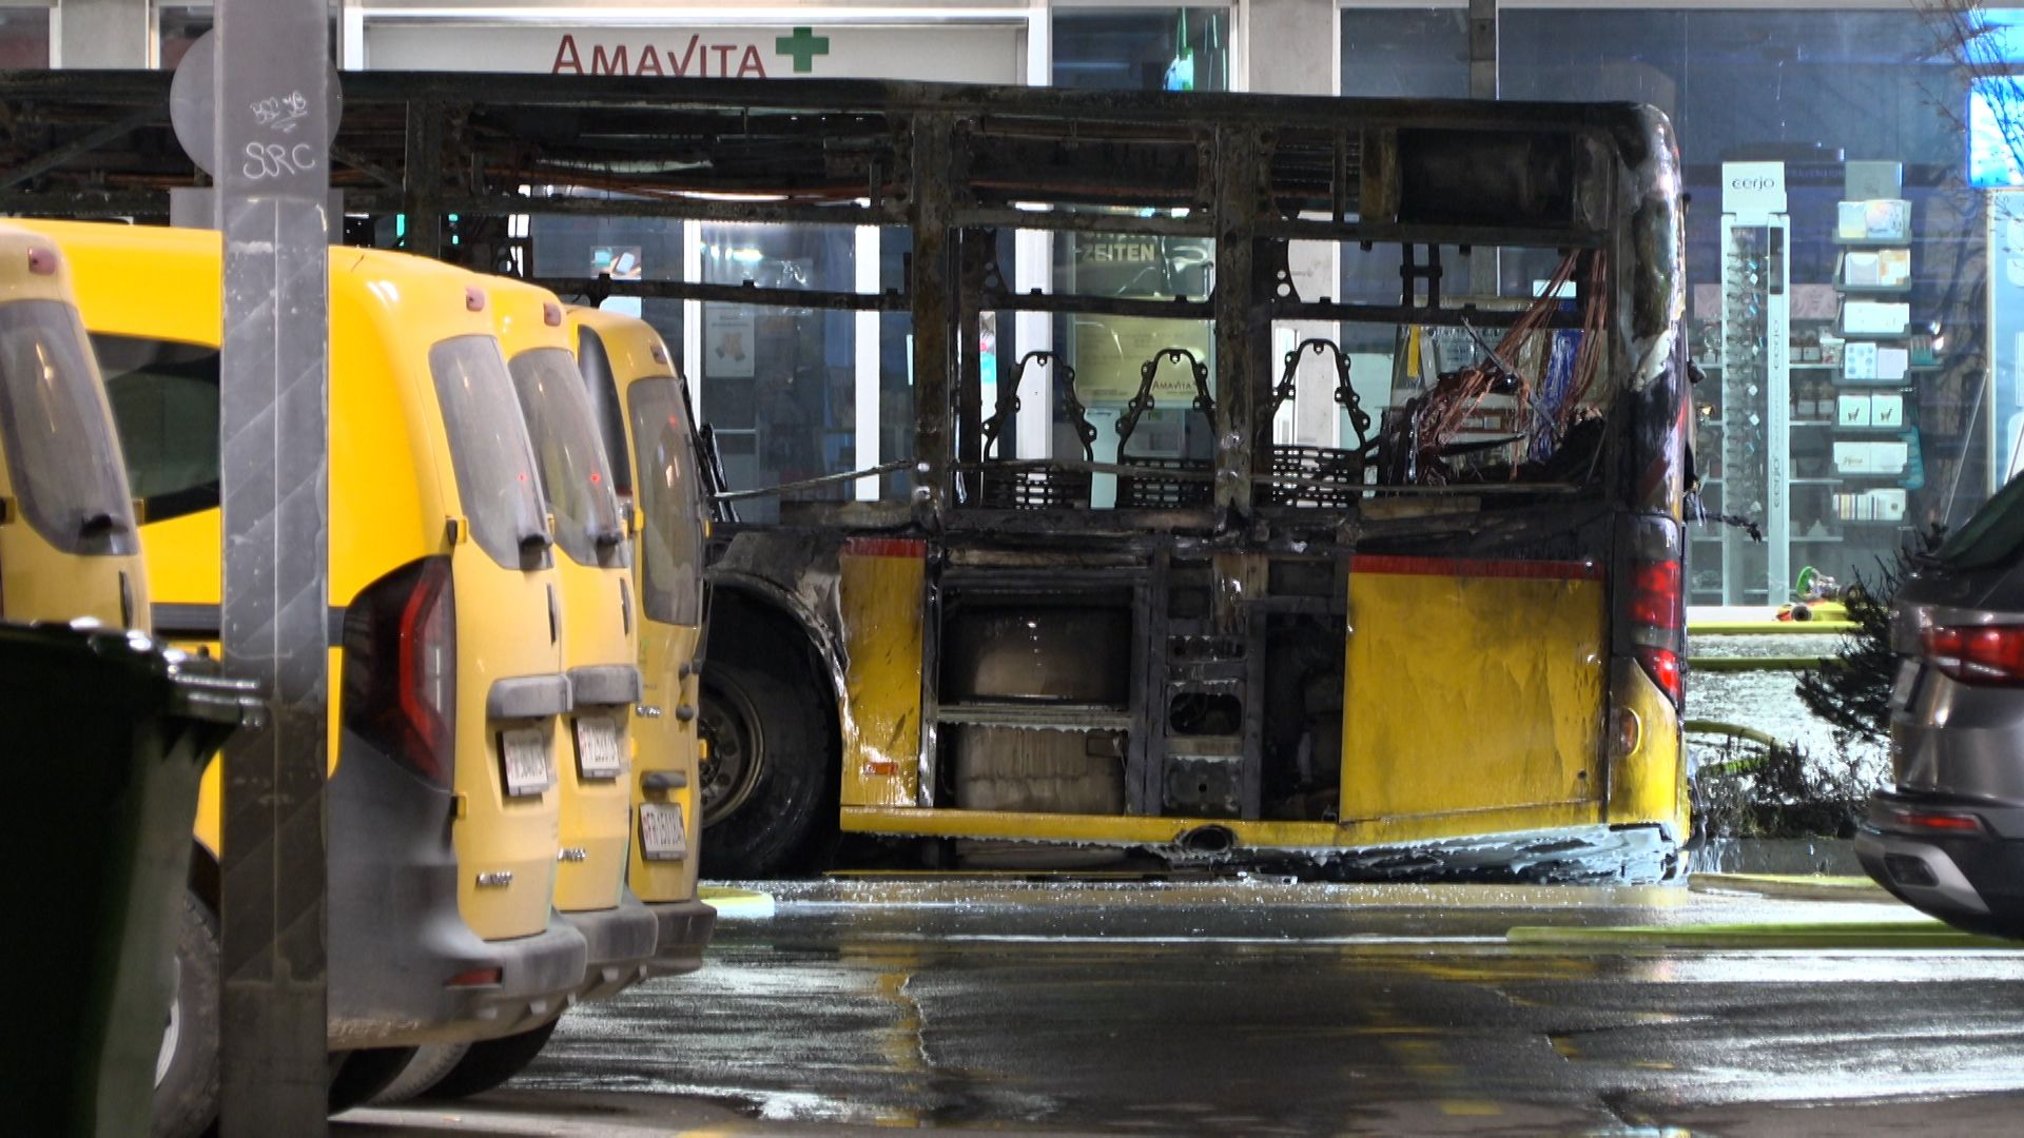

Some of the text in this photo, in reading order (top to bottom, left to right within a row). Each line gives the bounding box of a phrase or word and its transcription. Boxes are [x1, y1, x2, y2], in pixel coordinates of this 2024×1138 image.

[551, 33, 767, 78] AMAVITA
[242, 141, 316, 180] SRC
[1731, 176, 1775, 192] cerjo
[1081, 243, 1155, 262] ZEITEN
